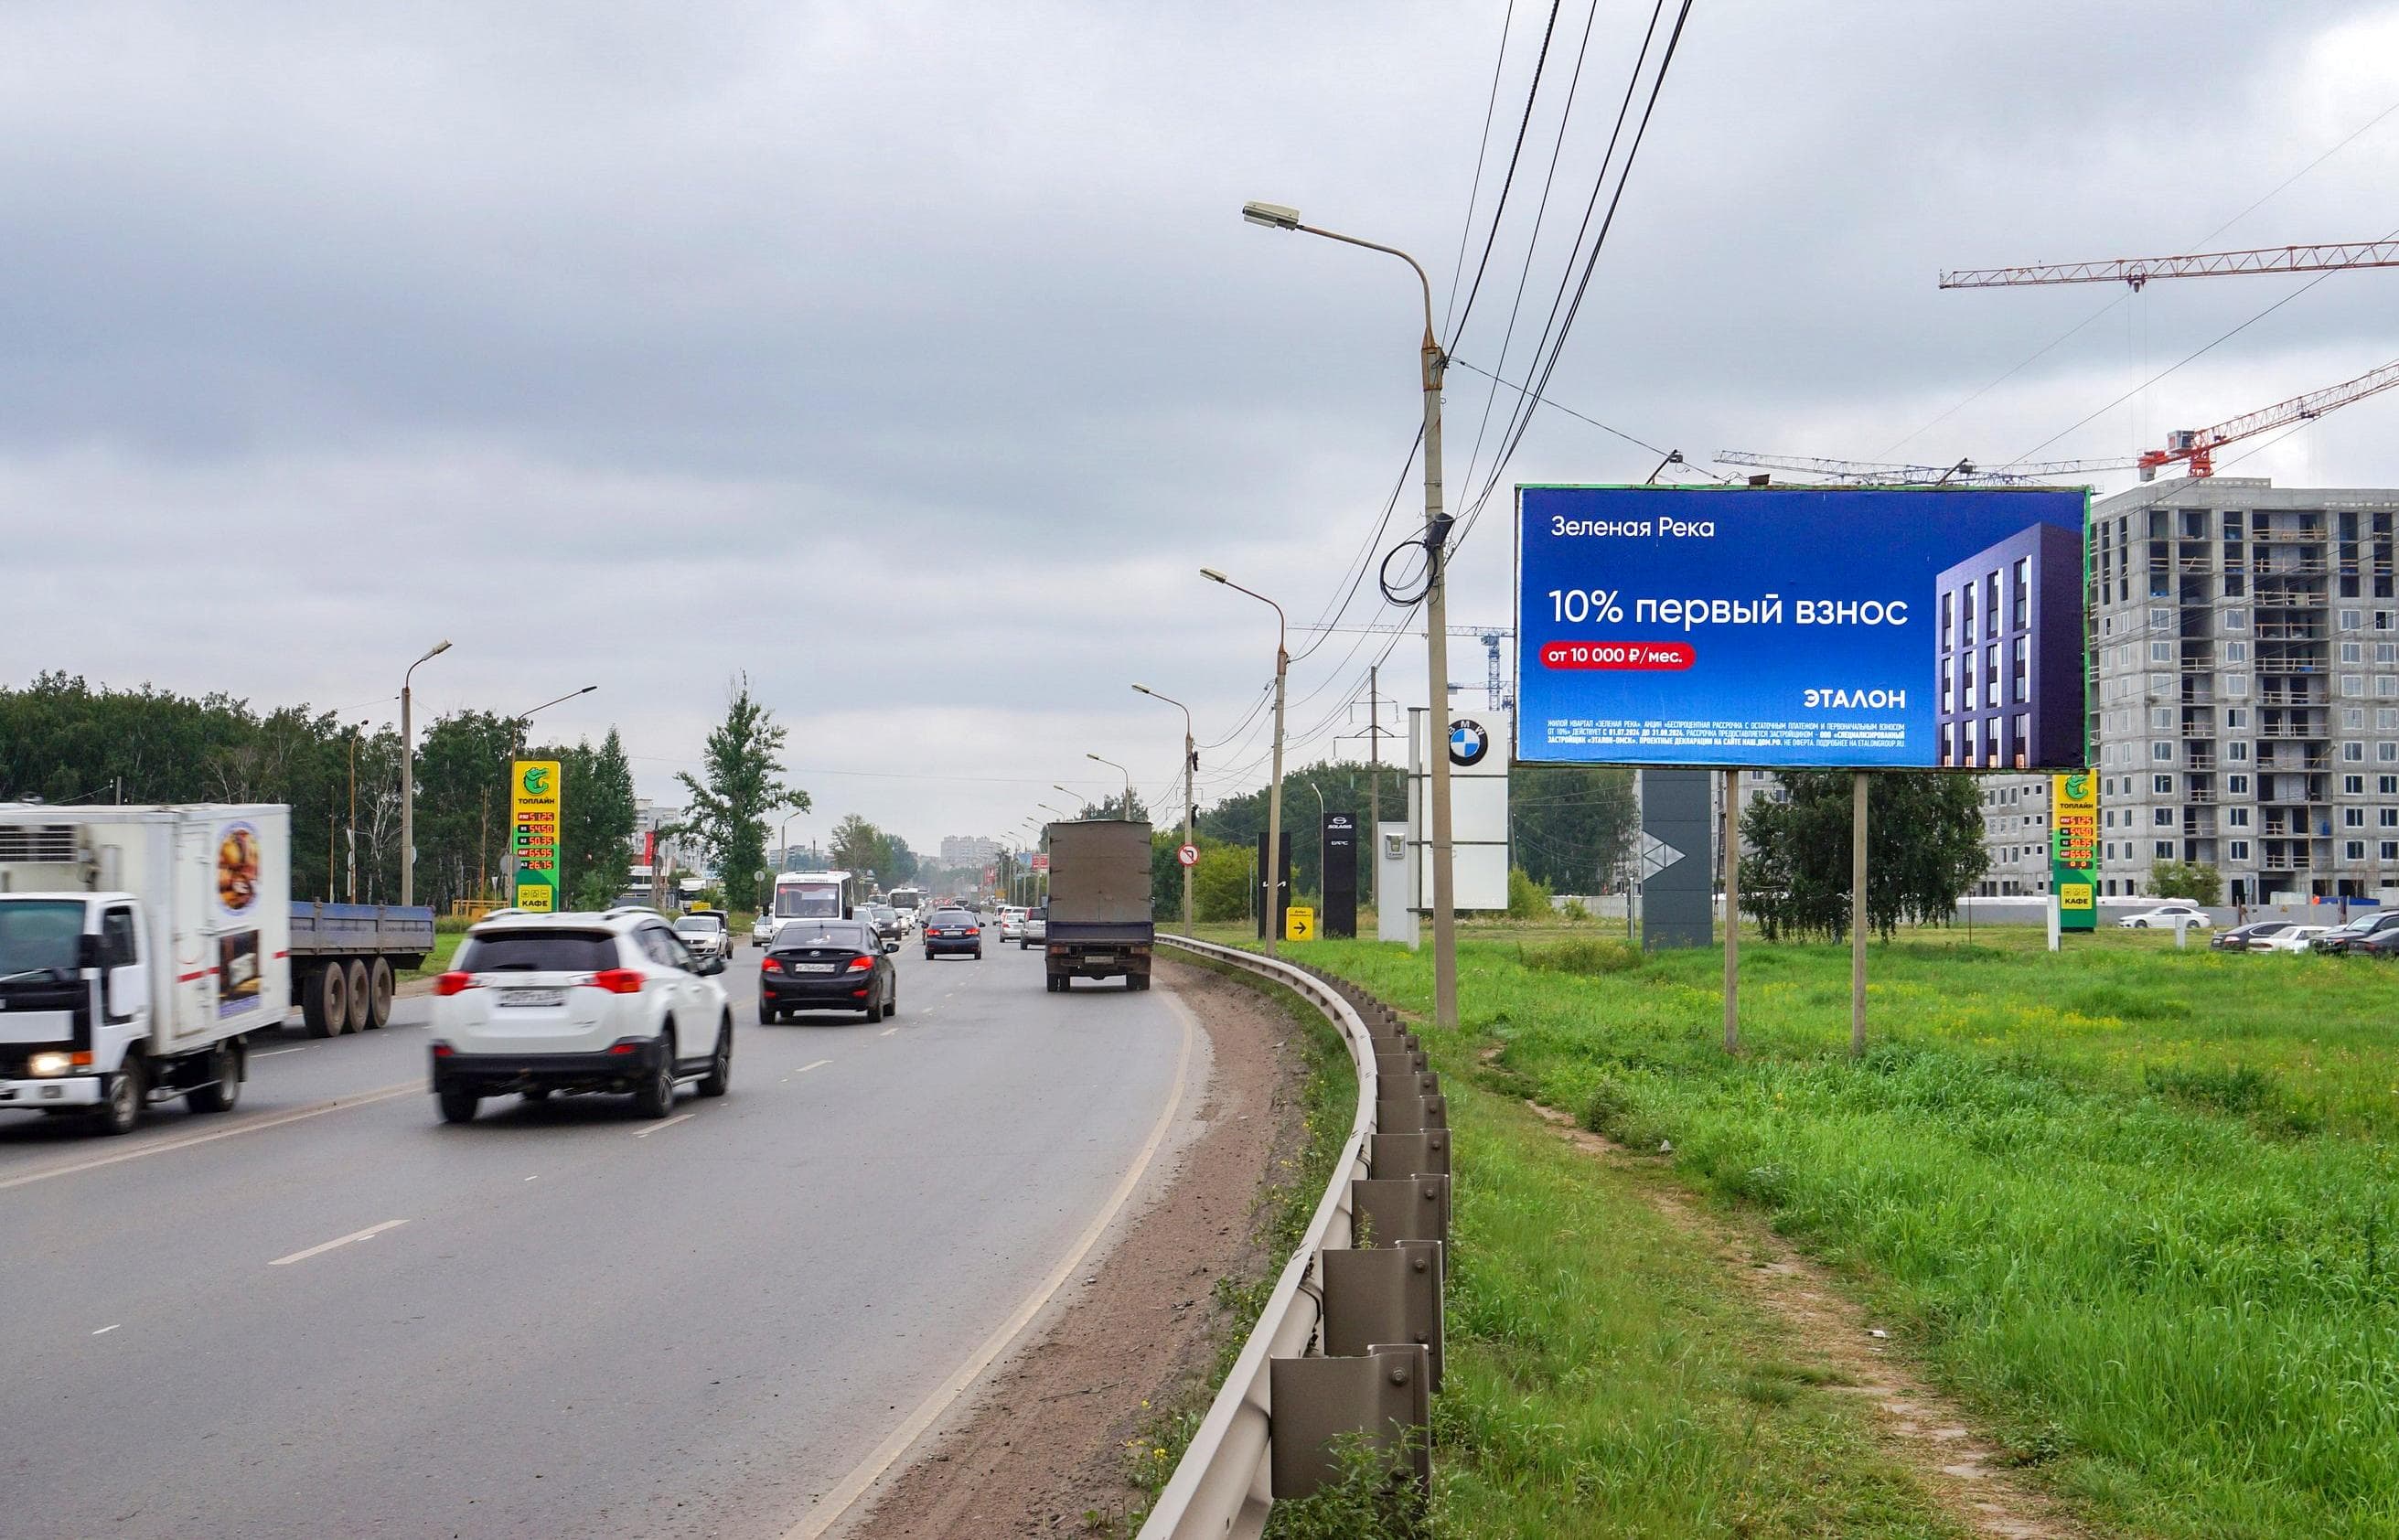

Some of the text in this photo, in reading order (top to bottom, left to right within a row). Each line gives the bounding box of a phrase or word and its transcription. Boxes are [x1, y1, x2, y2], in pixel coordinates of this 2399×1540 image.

[1551, 516, 1715, 537] Зеленая Река
[1548, 589, 1908, 631] 10% первый взнос
[1548, 650, 1567, 662] от
[1570, 647, 1588, 662] 10
[1591, 647, 1624, 662] 000
[1804, 689, 1905, 709] ЭТАЛОН
[1448, 721, 1485, 735] BMW
[1826, 722, 1877, 731] ПЕРВОНАЧАЛЬНЫМ
[1723, 737, 1741, 745] САЙТЕ
